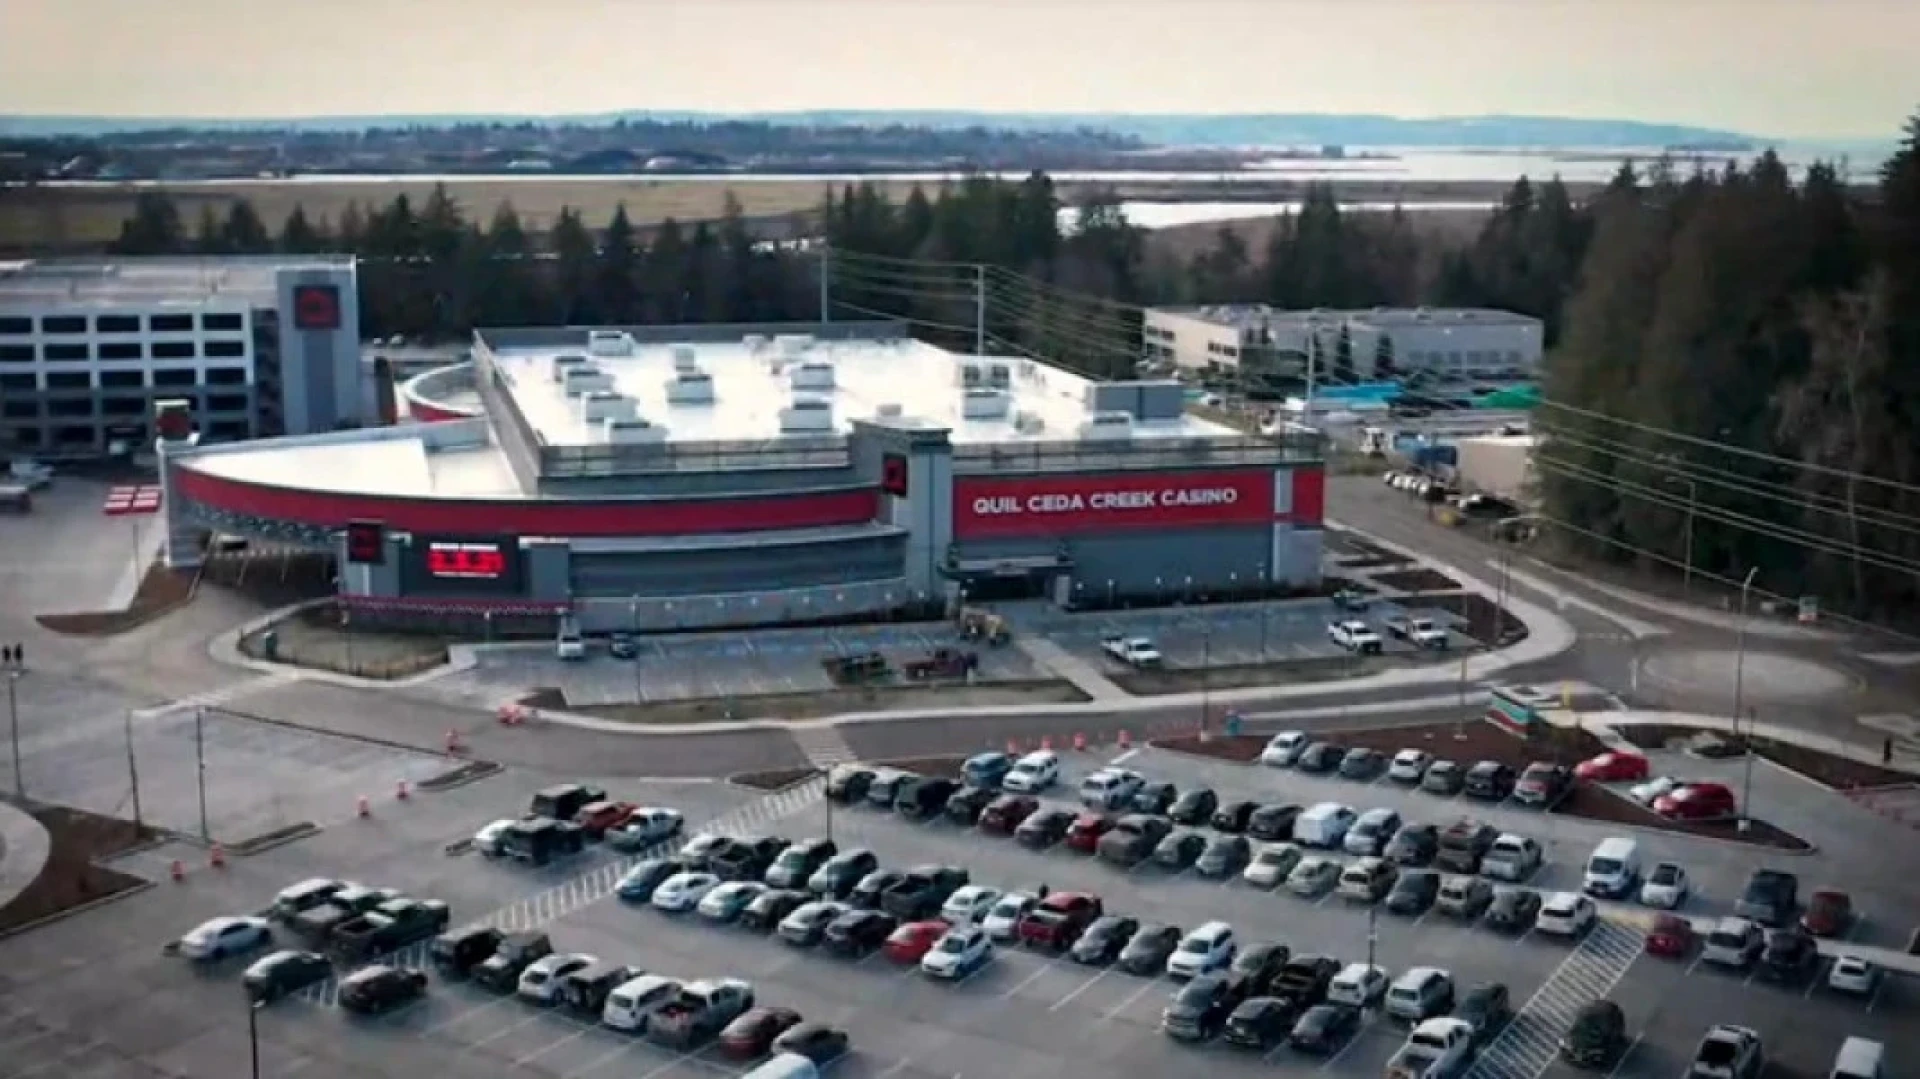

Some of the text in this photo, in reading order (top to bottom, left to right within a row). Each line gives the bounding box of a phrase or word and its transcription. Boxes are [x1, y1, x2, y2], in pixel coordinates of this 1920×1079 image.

[973, 487, 1237, 514] QUIL CEDA CREEK CASINO
